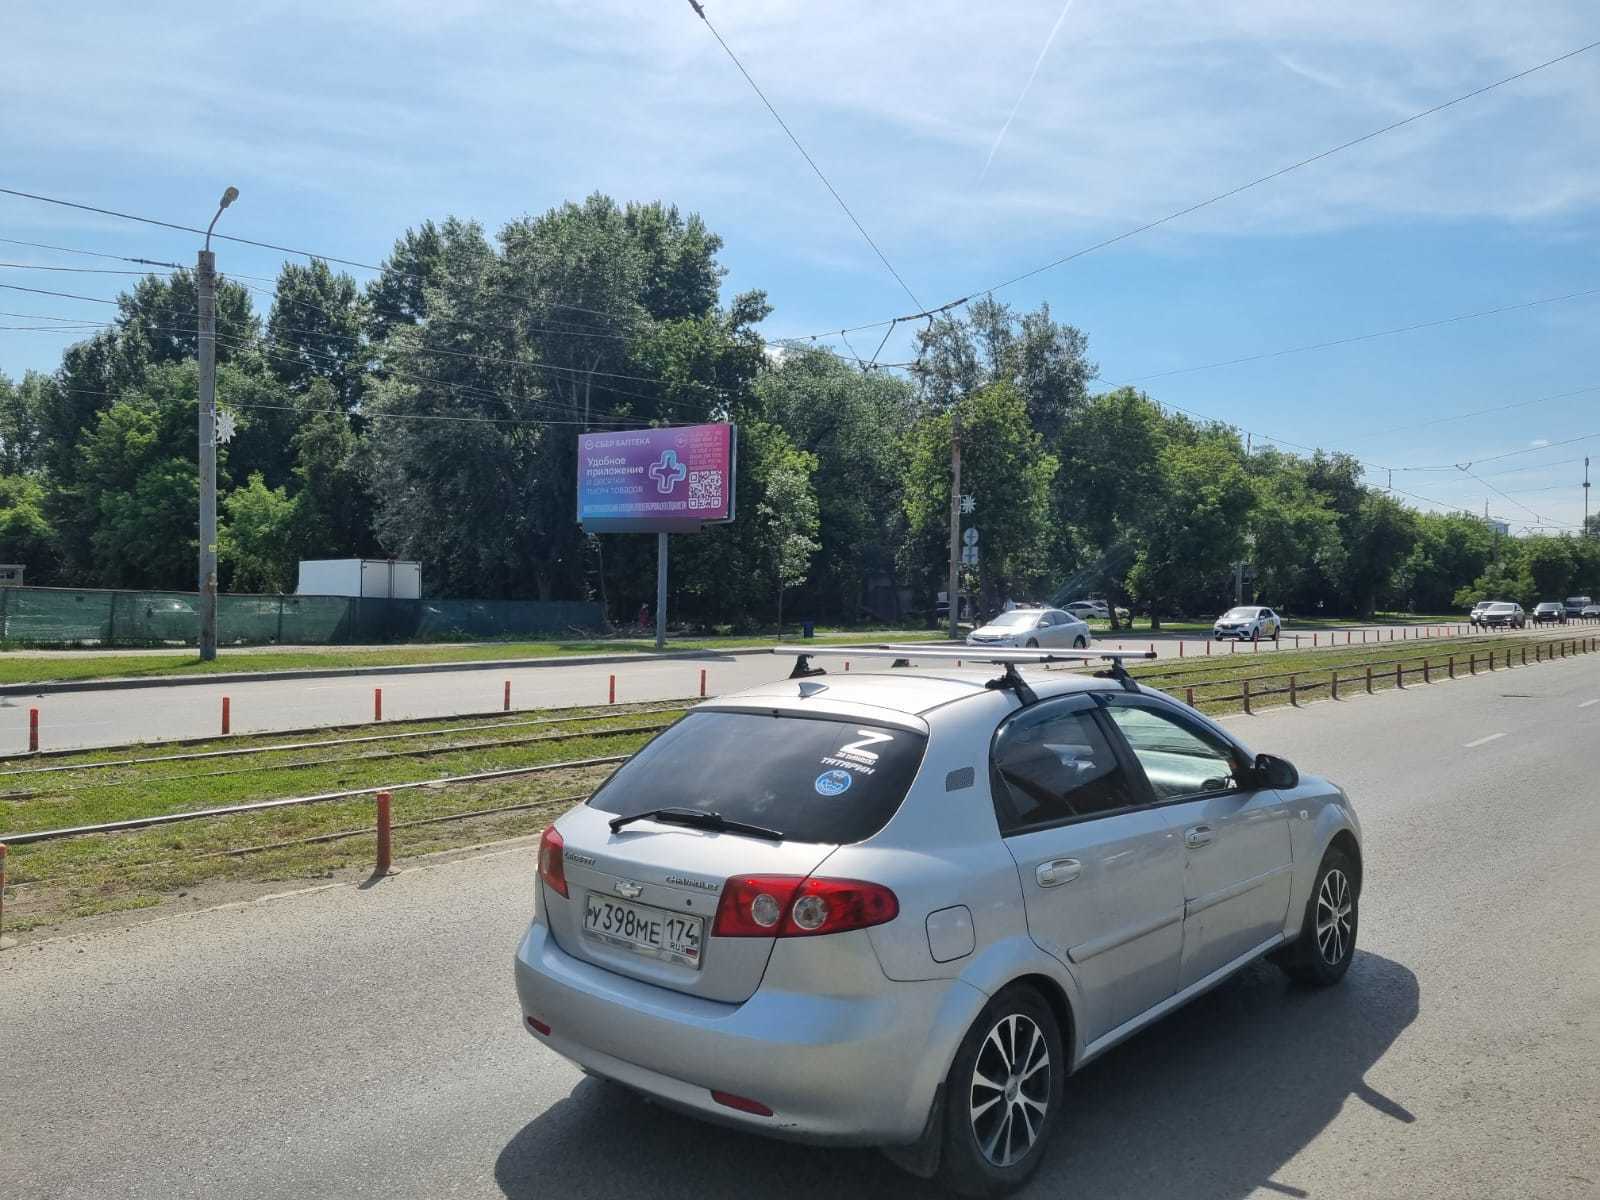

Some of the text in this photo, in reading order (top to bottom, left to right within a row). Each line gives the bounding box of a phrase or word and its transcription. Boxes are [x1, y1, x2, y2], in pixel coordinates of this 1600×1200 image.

[587, 455, 626, 468] Удобное
[586, 466, 644, 478] приложение
[611, 486, 644, 494] товаров
[821, 757, 876, 775] ТАТАРИН
[666, 918, 695, 946] 174
